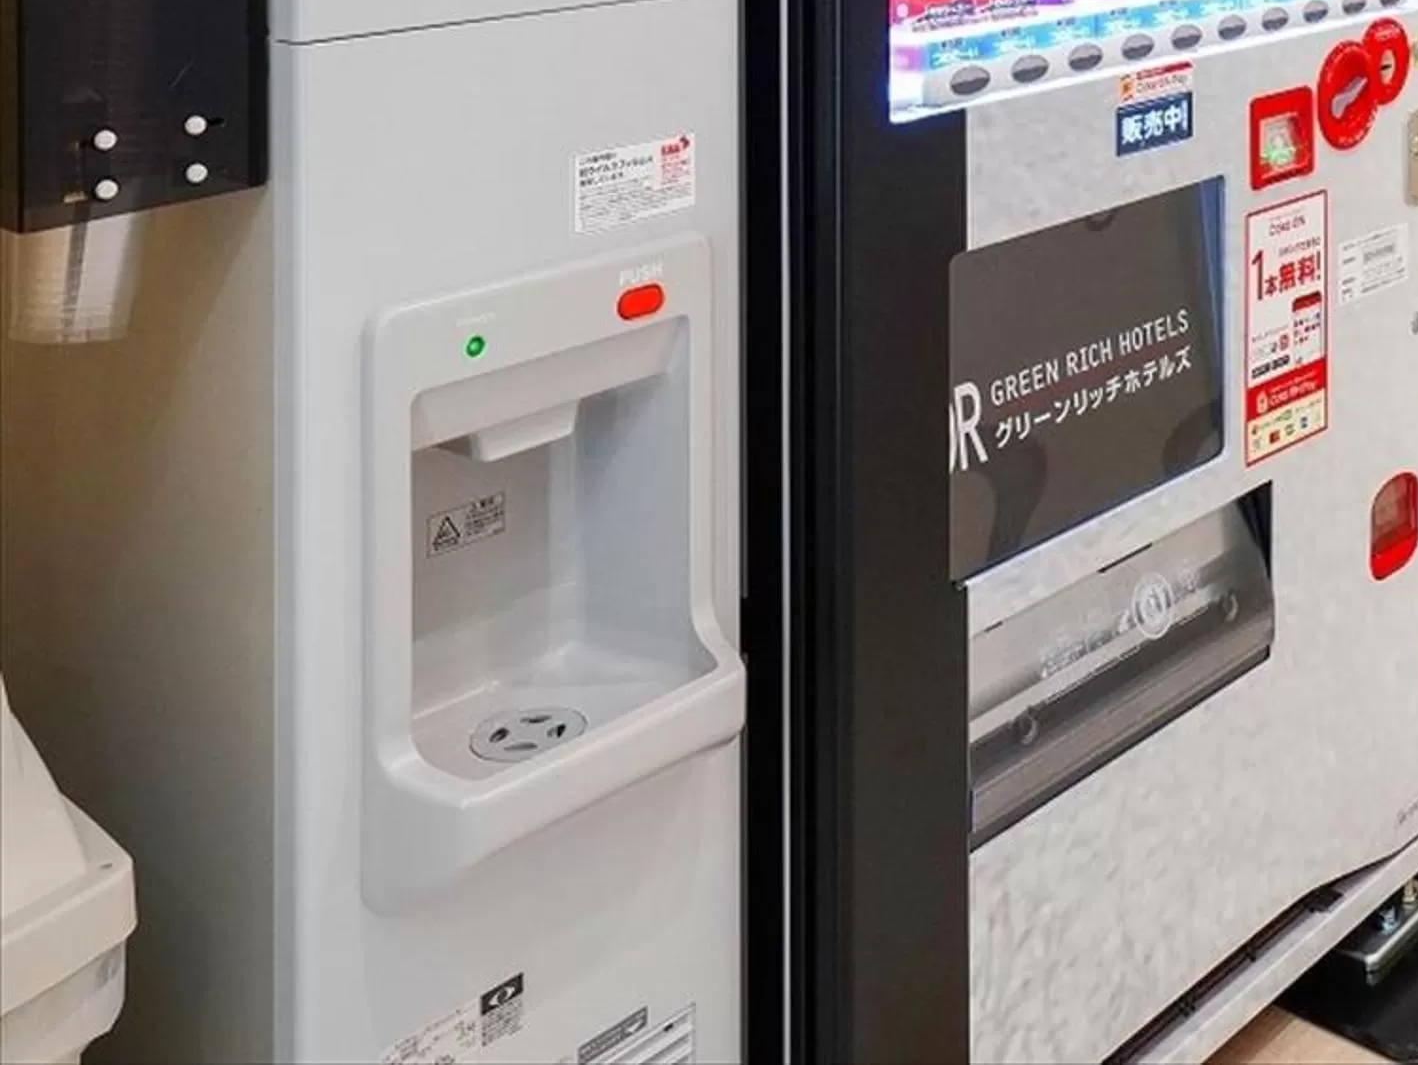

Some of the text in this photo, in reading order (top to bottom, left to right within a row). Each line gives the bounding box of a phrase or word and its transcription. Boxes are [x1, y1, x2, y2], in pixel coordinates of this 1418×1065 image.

[990, 358, 1060, 407] GREEN
[1065, 337, 1114, 377] RICH
[1118, 308, 1191, 357] HOTELS
[995, 345, 1193, 449] グリーンリッチホテルズ
